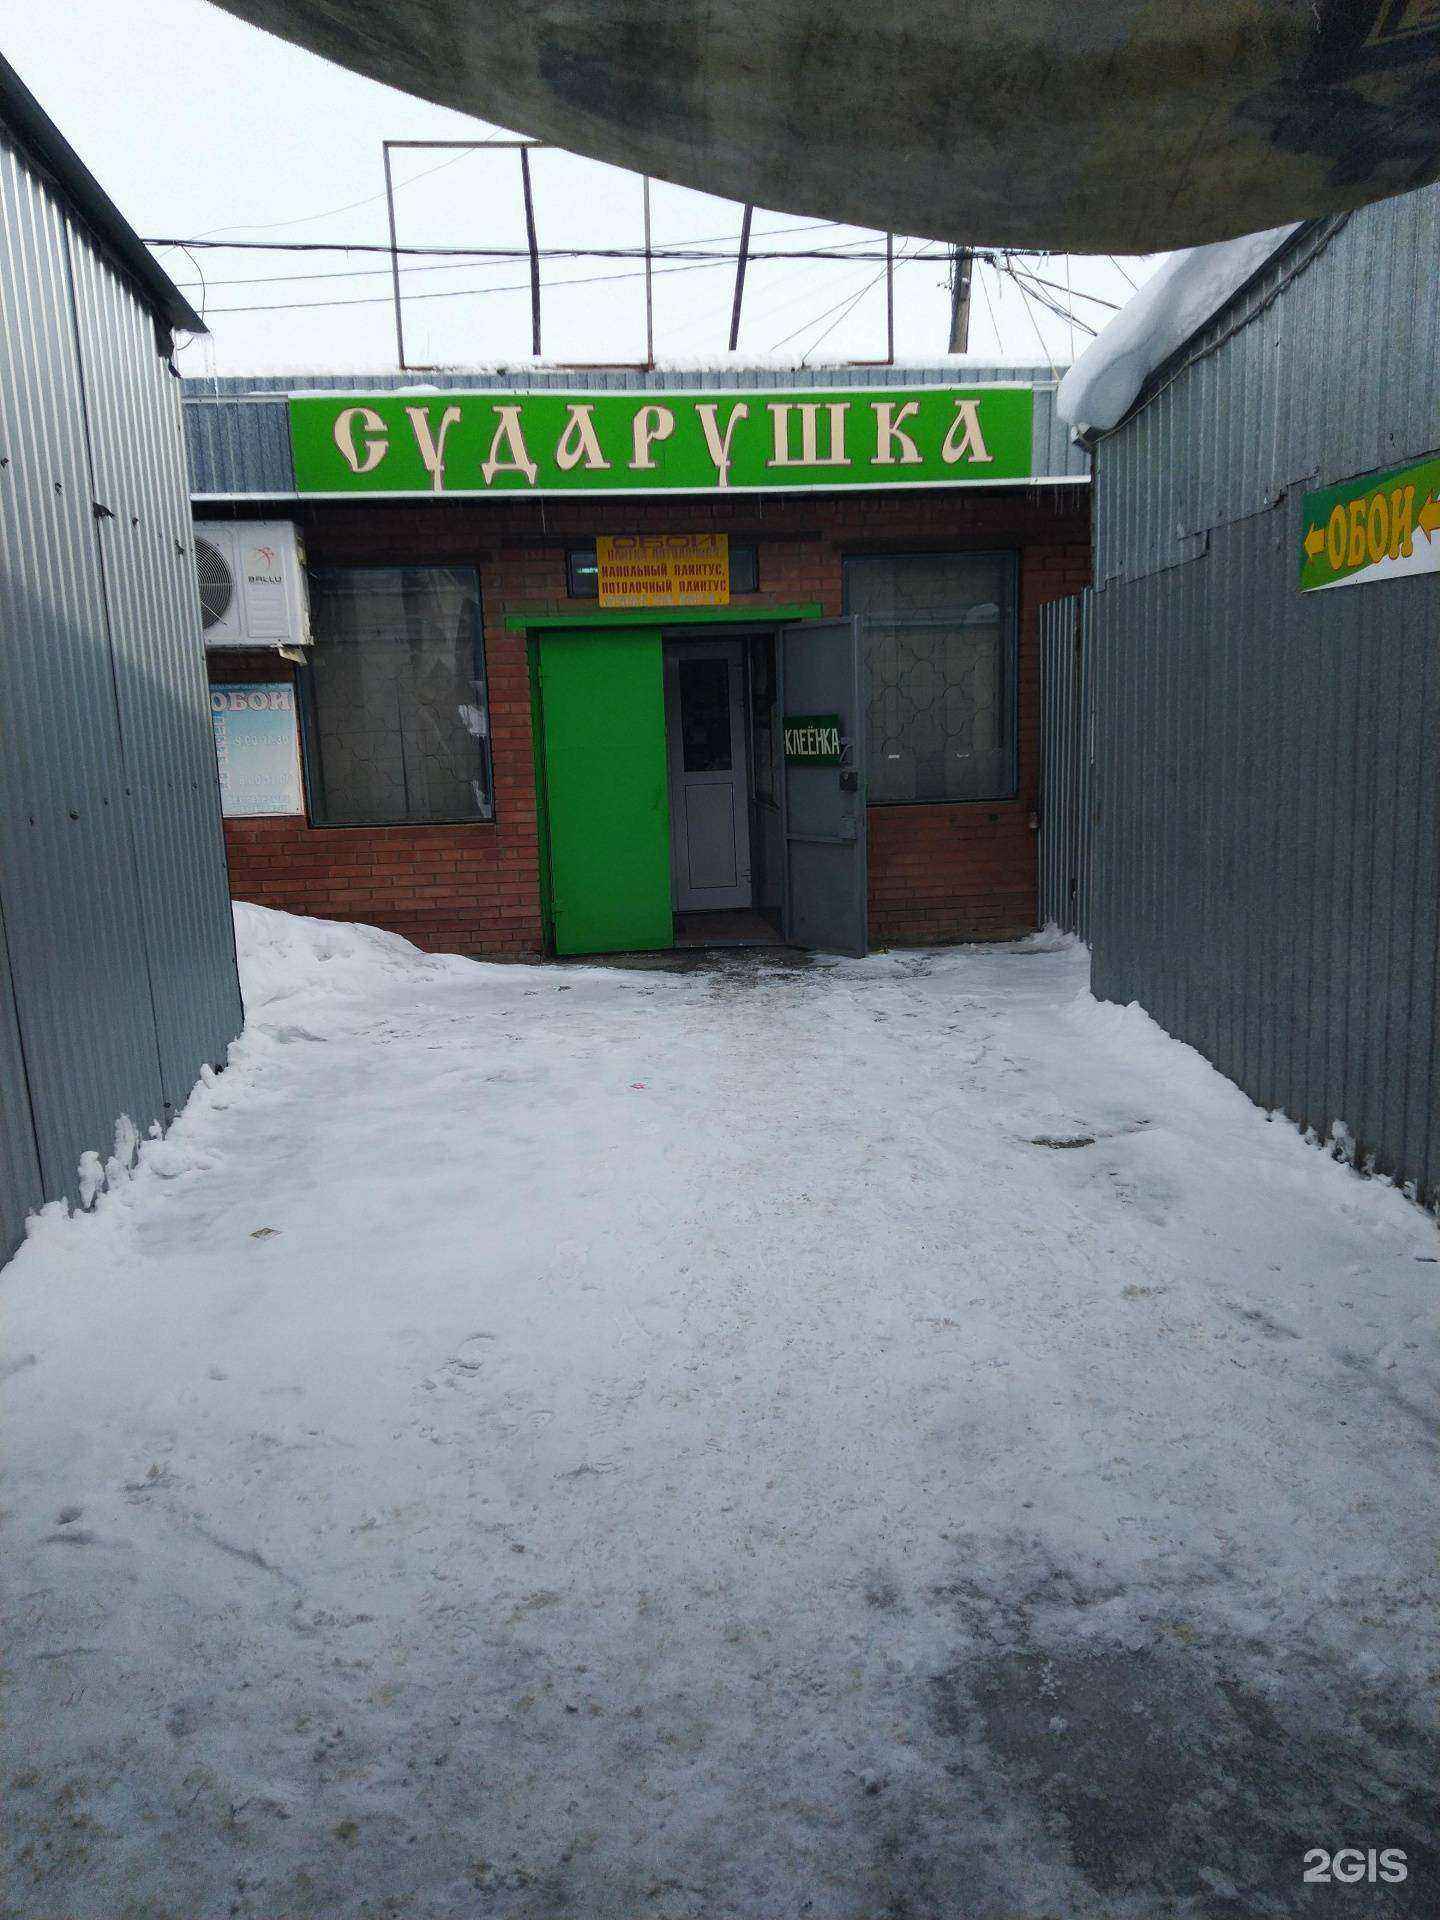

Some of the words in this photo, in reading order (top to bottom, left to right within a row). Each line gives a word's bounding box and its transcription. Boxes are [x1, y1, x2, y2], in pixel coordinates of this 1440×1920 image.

[333, 400, 994, 491] СУДАРУШКА
[1328, 484, 1416, 571] ОБОИ
[247, 574, 282, 584] BALLU
[602, 580, 672, 593] ПОТОЛОЧНЫЙ
[679, 579, 726, 592] ПЛИНТУС
[210, 691, 292, 711] ОБОИ
[784, 725, 840, 755] КЛЕЁНКА
